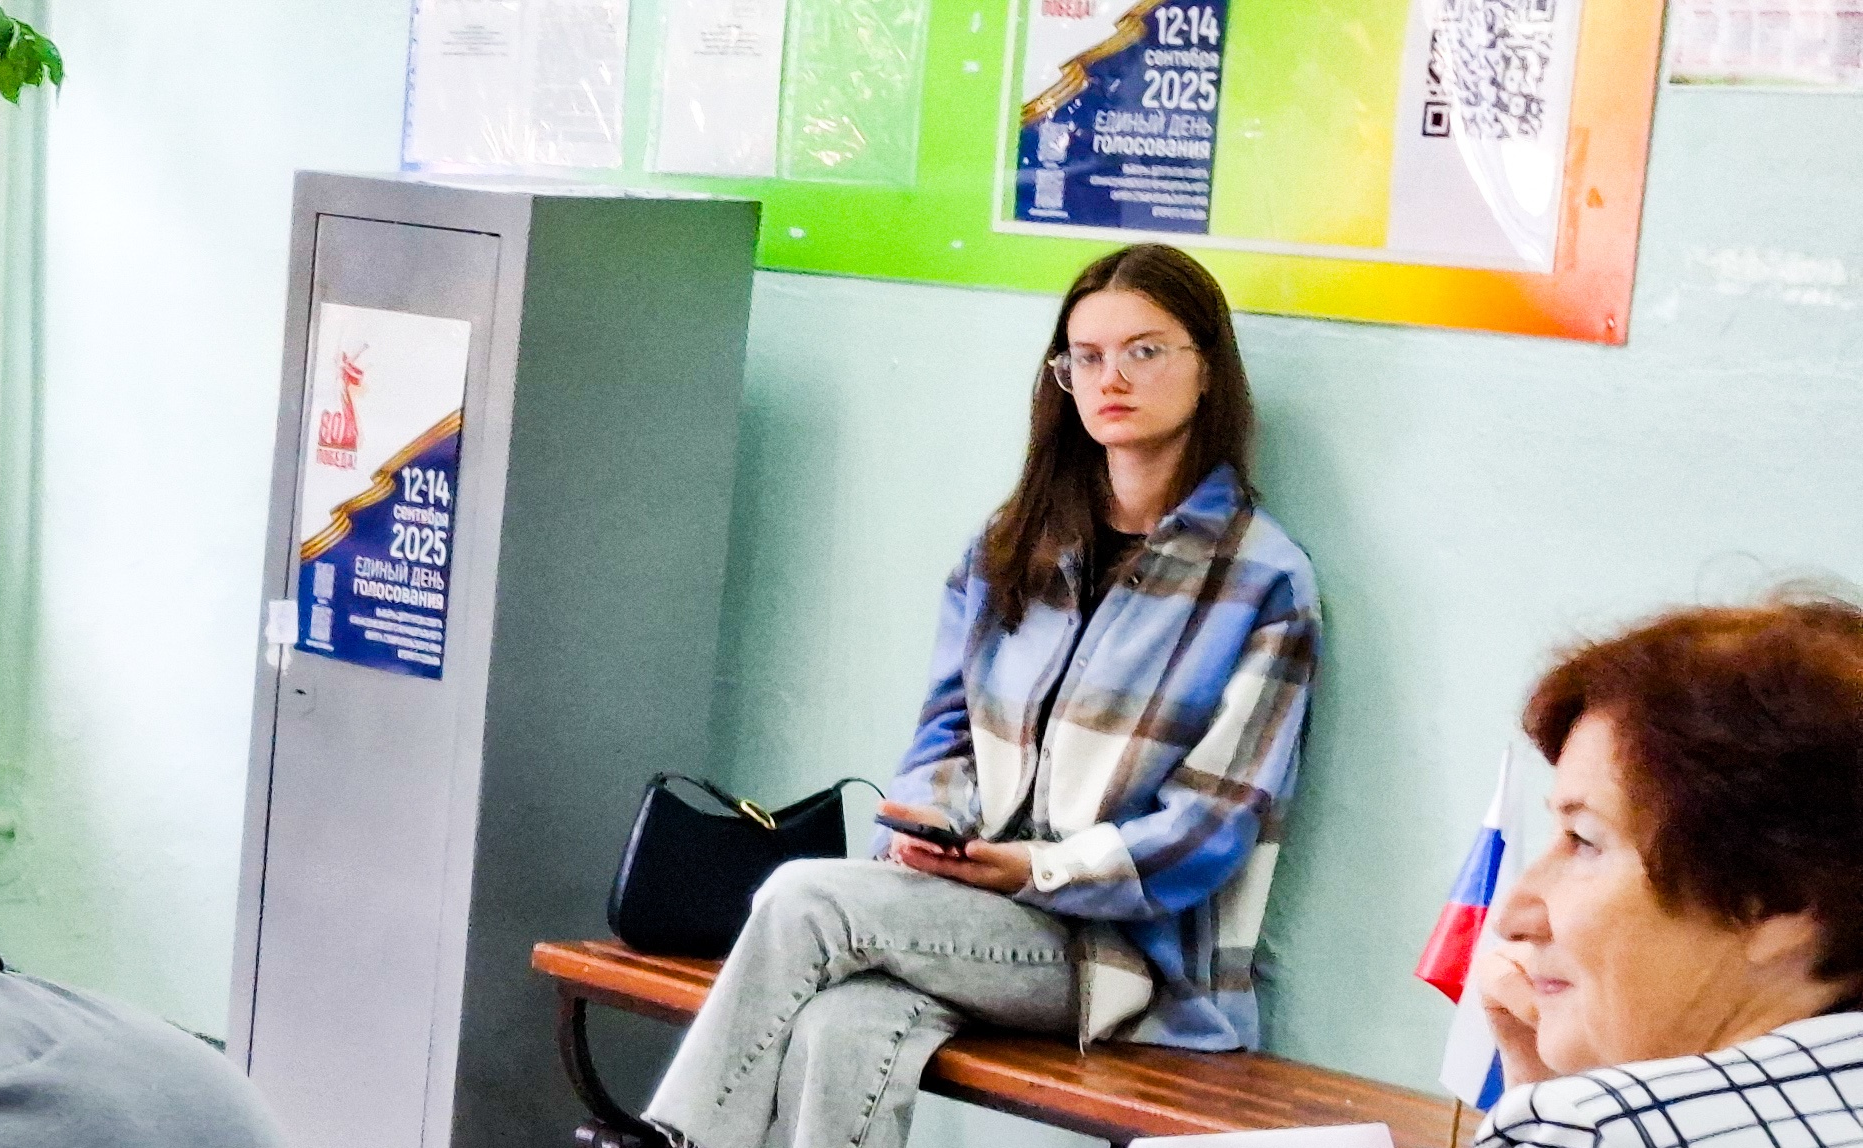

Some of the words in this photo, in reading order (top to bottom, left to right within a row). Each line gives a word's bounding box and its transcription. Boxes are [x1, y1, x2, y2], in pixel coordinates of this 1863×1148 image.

[1155, 6, 1220, 46] 12-14
[1142, 70, 1218, 112] 2025
[1168, 113, 1213, 139] ДЕНЬ
[401, 467, 451, 506] 12-14
[389, 524, 448, 567] 2025
[354, 555, 409, 585] ЕДИНЫЙ
[410, 566, 445, 591] ДЕНЬ
